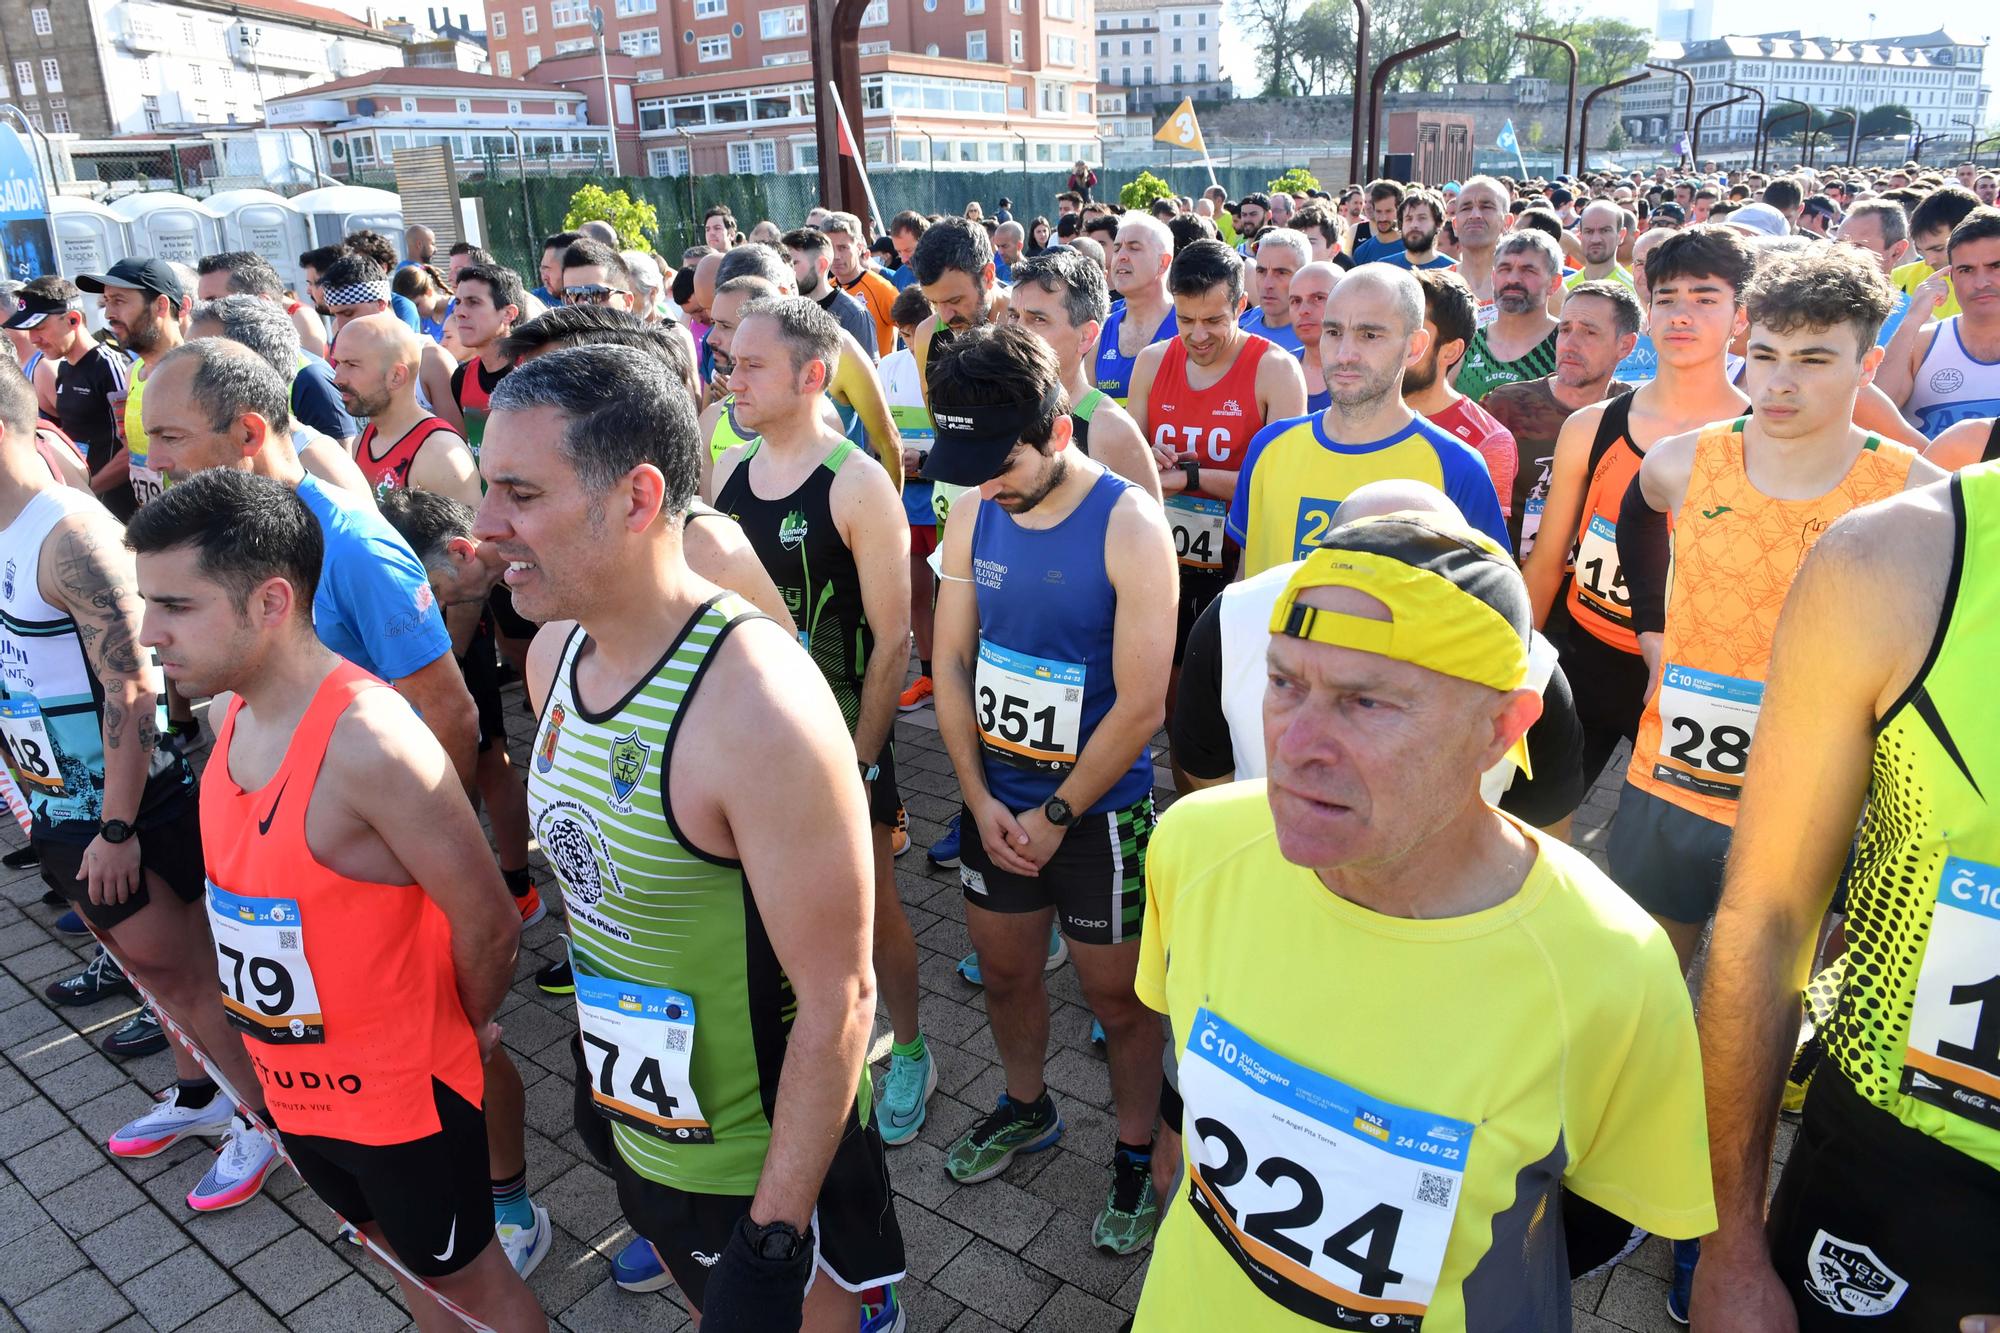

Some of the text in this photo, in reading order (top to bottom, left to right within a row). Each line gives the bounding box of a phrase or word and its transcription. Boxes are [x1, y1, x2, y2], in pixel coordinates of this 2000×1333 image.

[1176, 112, 1194, 144] 3
[1485, 371, 1518, 382] LUCUS
[779, 526, 808, 538] Running
[976, 567, 1003, 582] FLUVIAL
[979, 685, 1065, 753] 351
[1670, 716, 1751, 775] 28
[597, 918, 630, 940] Piñeiro
[1074, 918, 1108, 928] OCHO
[622, 994, 637, 1003] PAZ
[1236, 1060, 1269, 1085] Popular
[1239, 1052, 1290, 1087] XVI Carreira
[310, 1104, 333, 1112] VIVE
[1362, 1111, 1384, 1127] PAZ
[1272, 1112, 1337, 1147] Jose Angel Pita Torres
[1194, 1116, 1404, 1299] 224
[1828, 1245, 1887, 1285] LUGO
[1843, 1290, 1871, 1308] 2014
